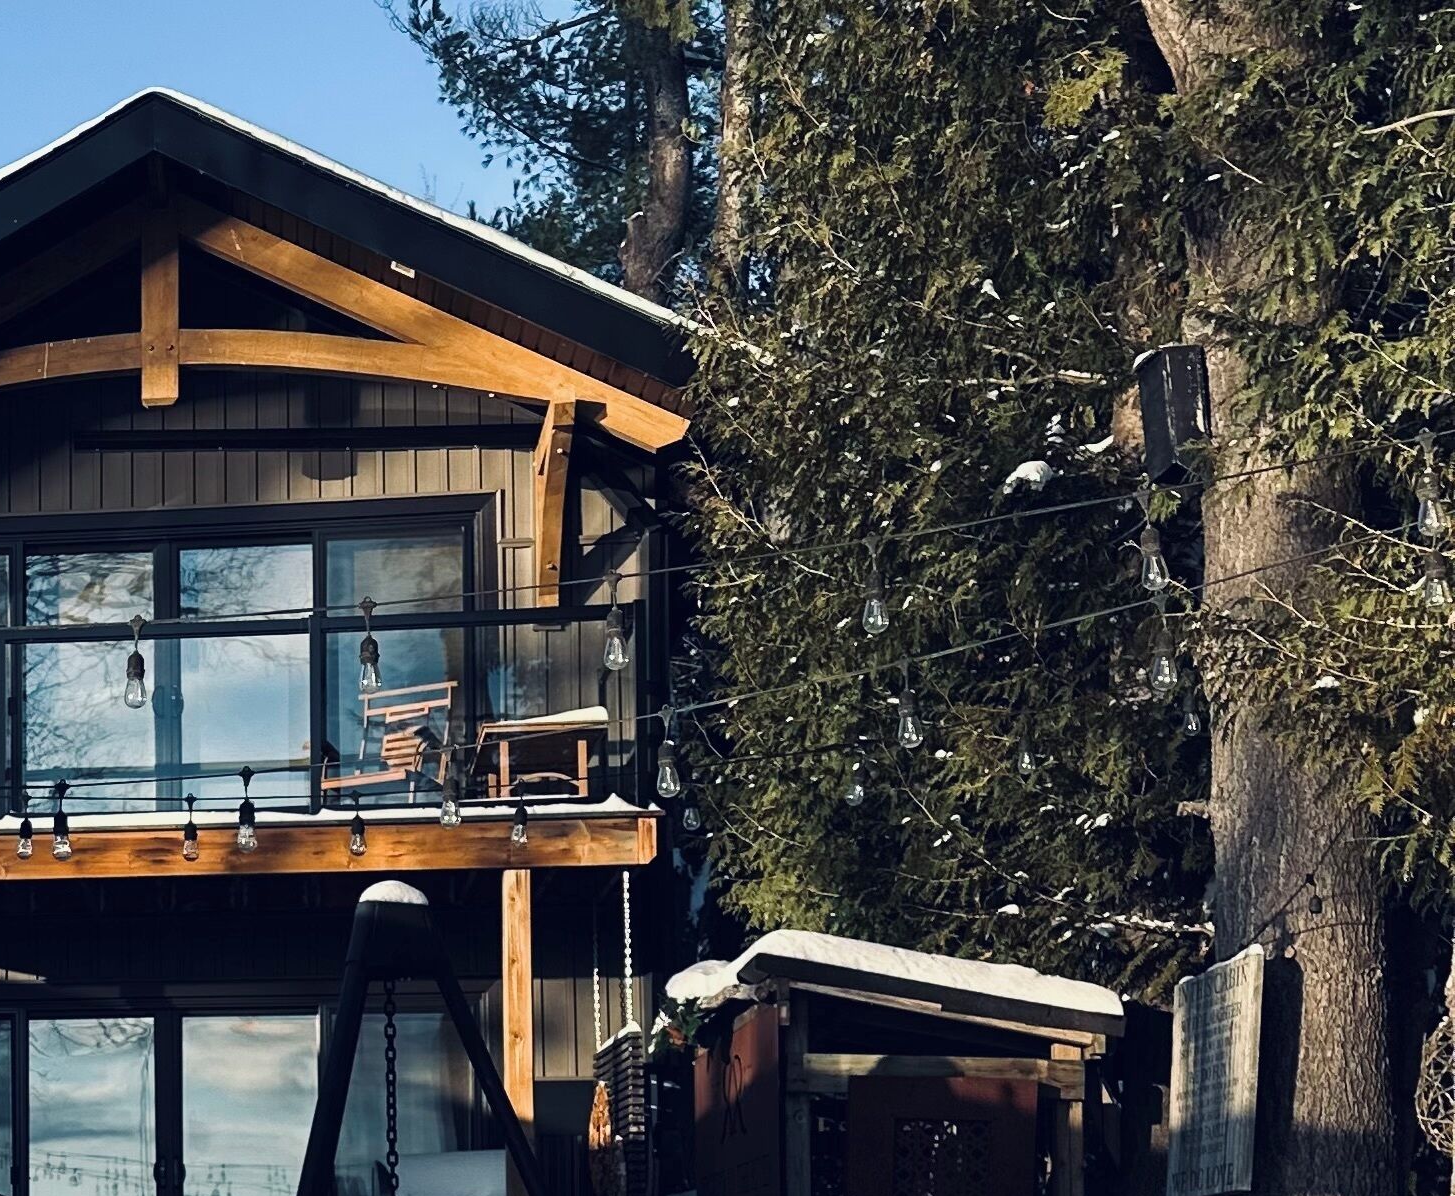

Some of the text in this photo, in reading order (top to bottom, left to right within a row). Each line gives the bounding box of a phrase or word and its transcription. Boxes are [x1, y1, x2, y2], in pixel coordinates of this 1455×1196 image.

[1214, 966, 1248, 993] CABIN
[1171, 1161, 1233, 1194] WE DO LOVE
